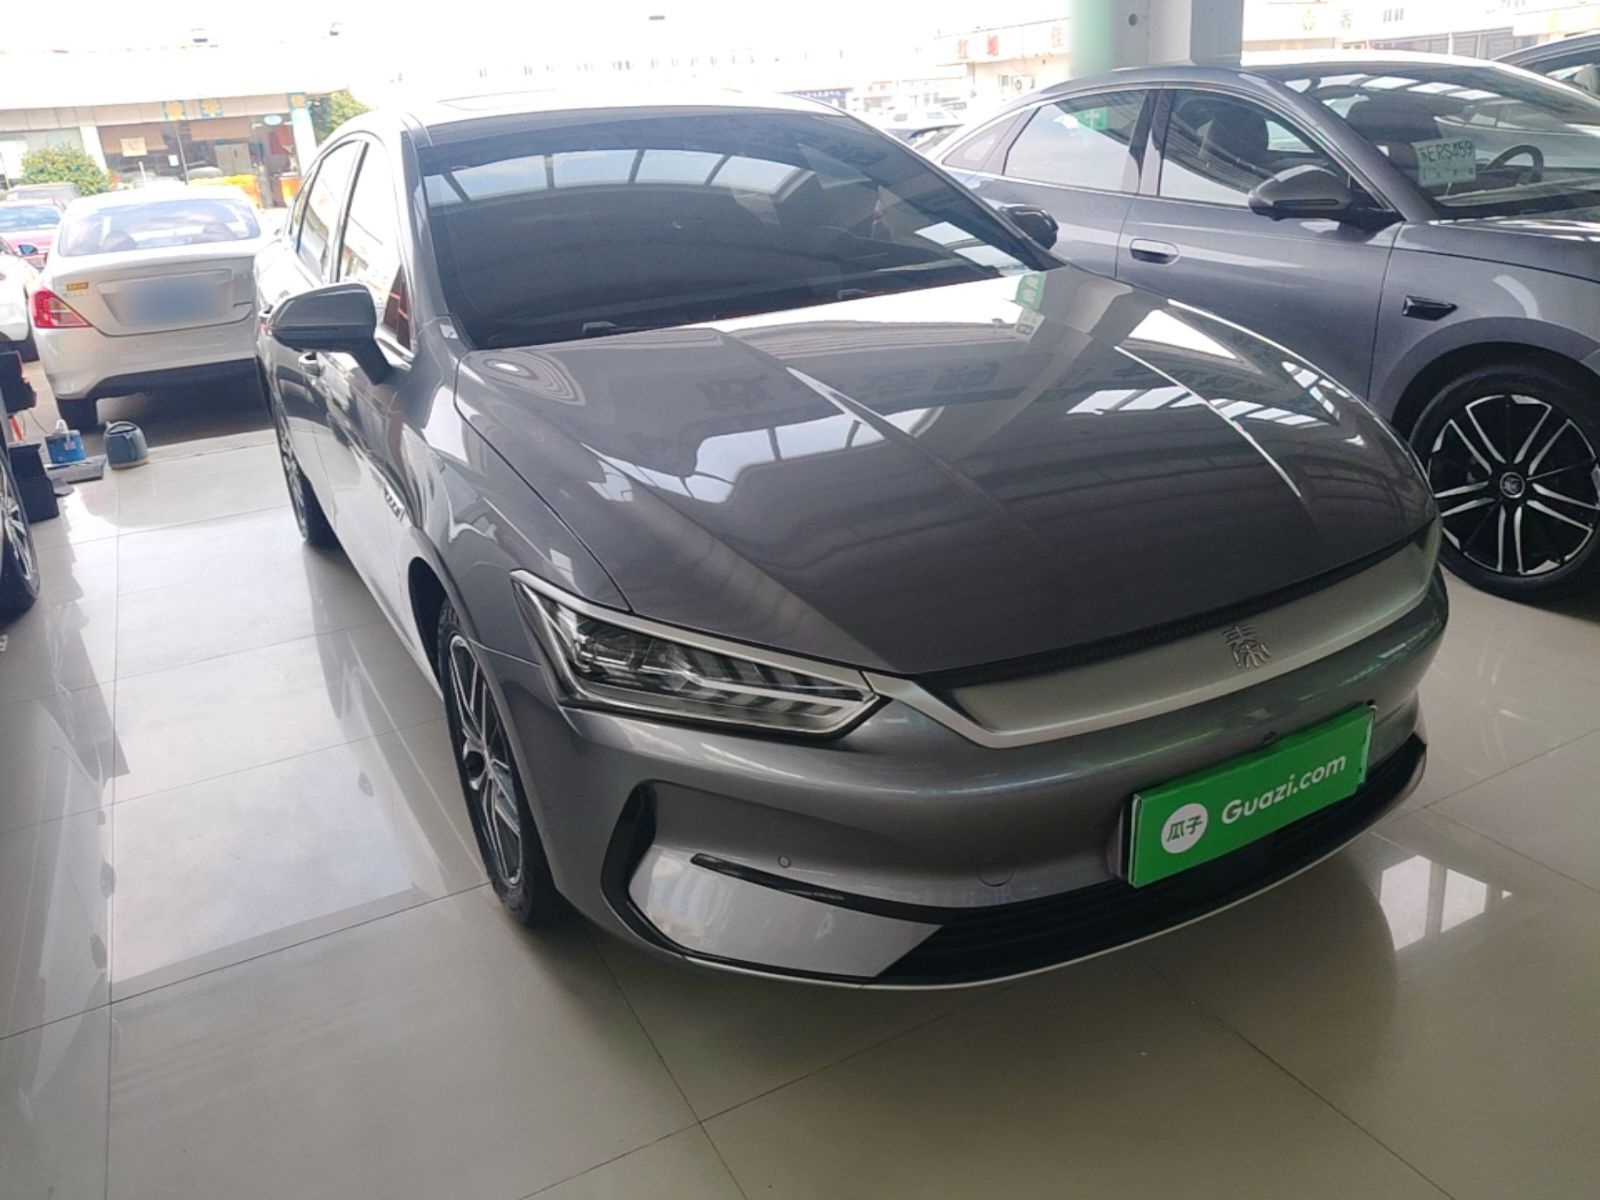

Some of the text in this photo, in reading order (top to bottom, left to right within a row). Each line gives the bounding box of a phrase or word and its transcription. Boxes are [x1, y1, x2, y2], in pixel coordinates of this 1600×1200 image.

[1221, 624, 1271, 669] 秦
[1221, 755, 1346, 825] Guazi.com
[1165, 815, 1204, 843] 瓜子
